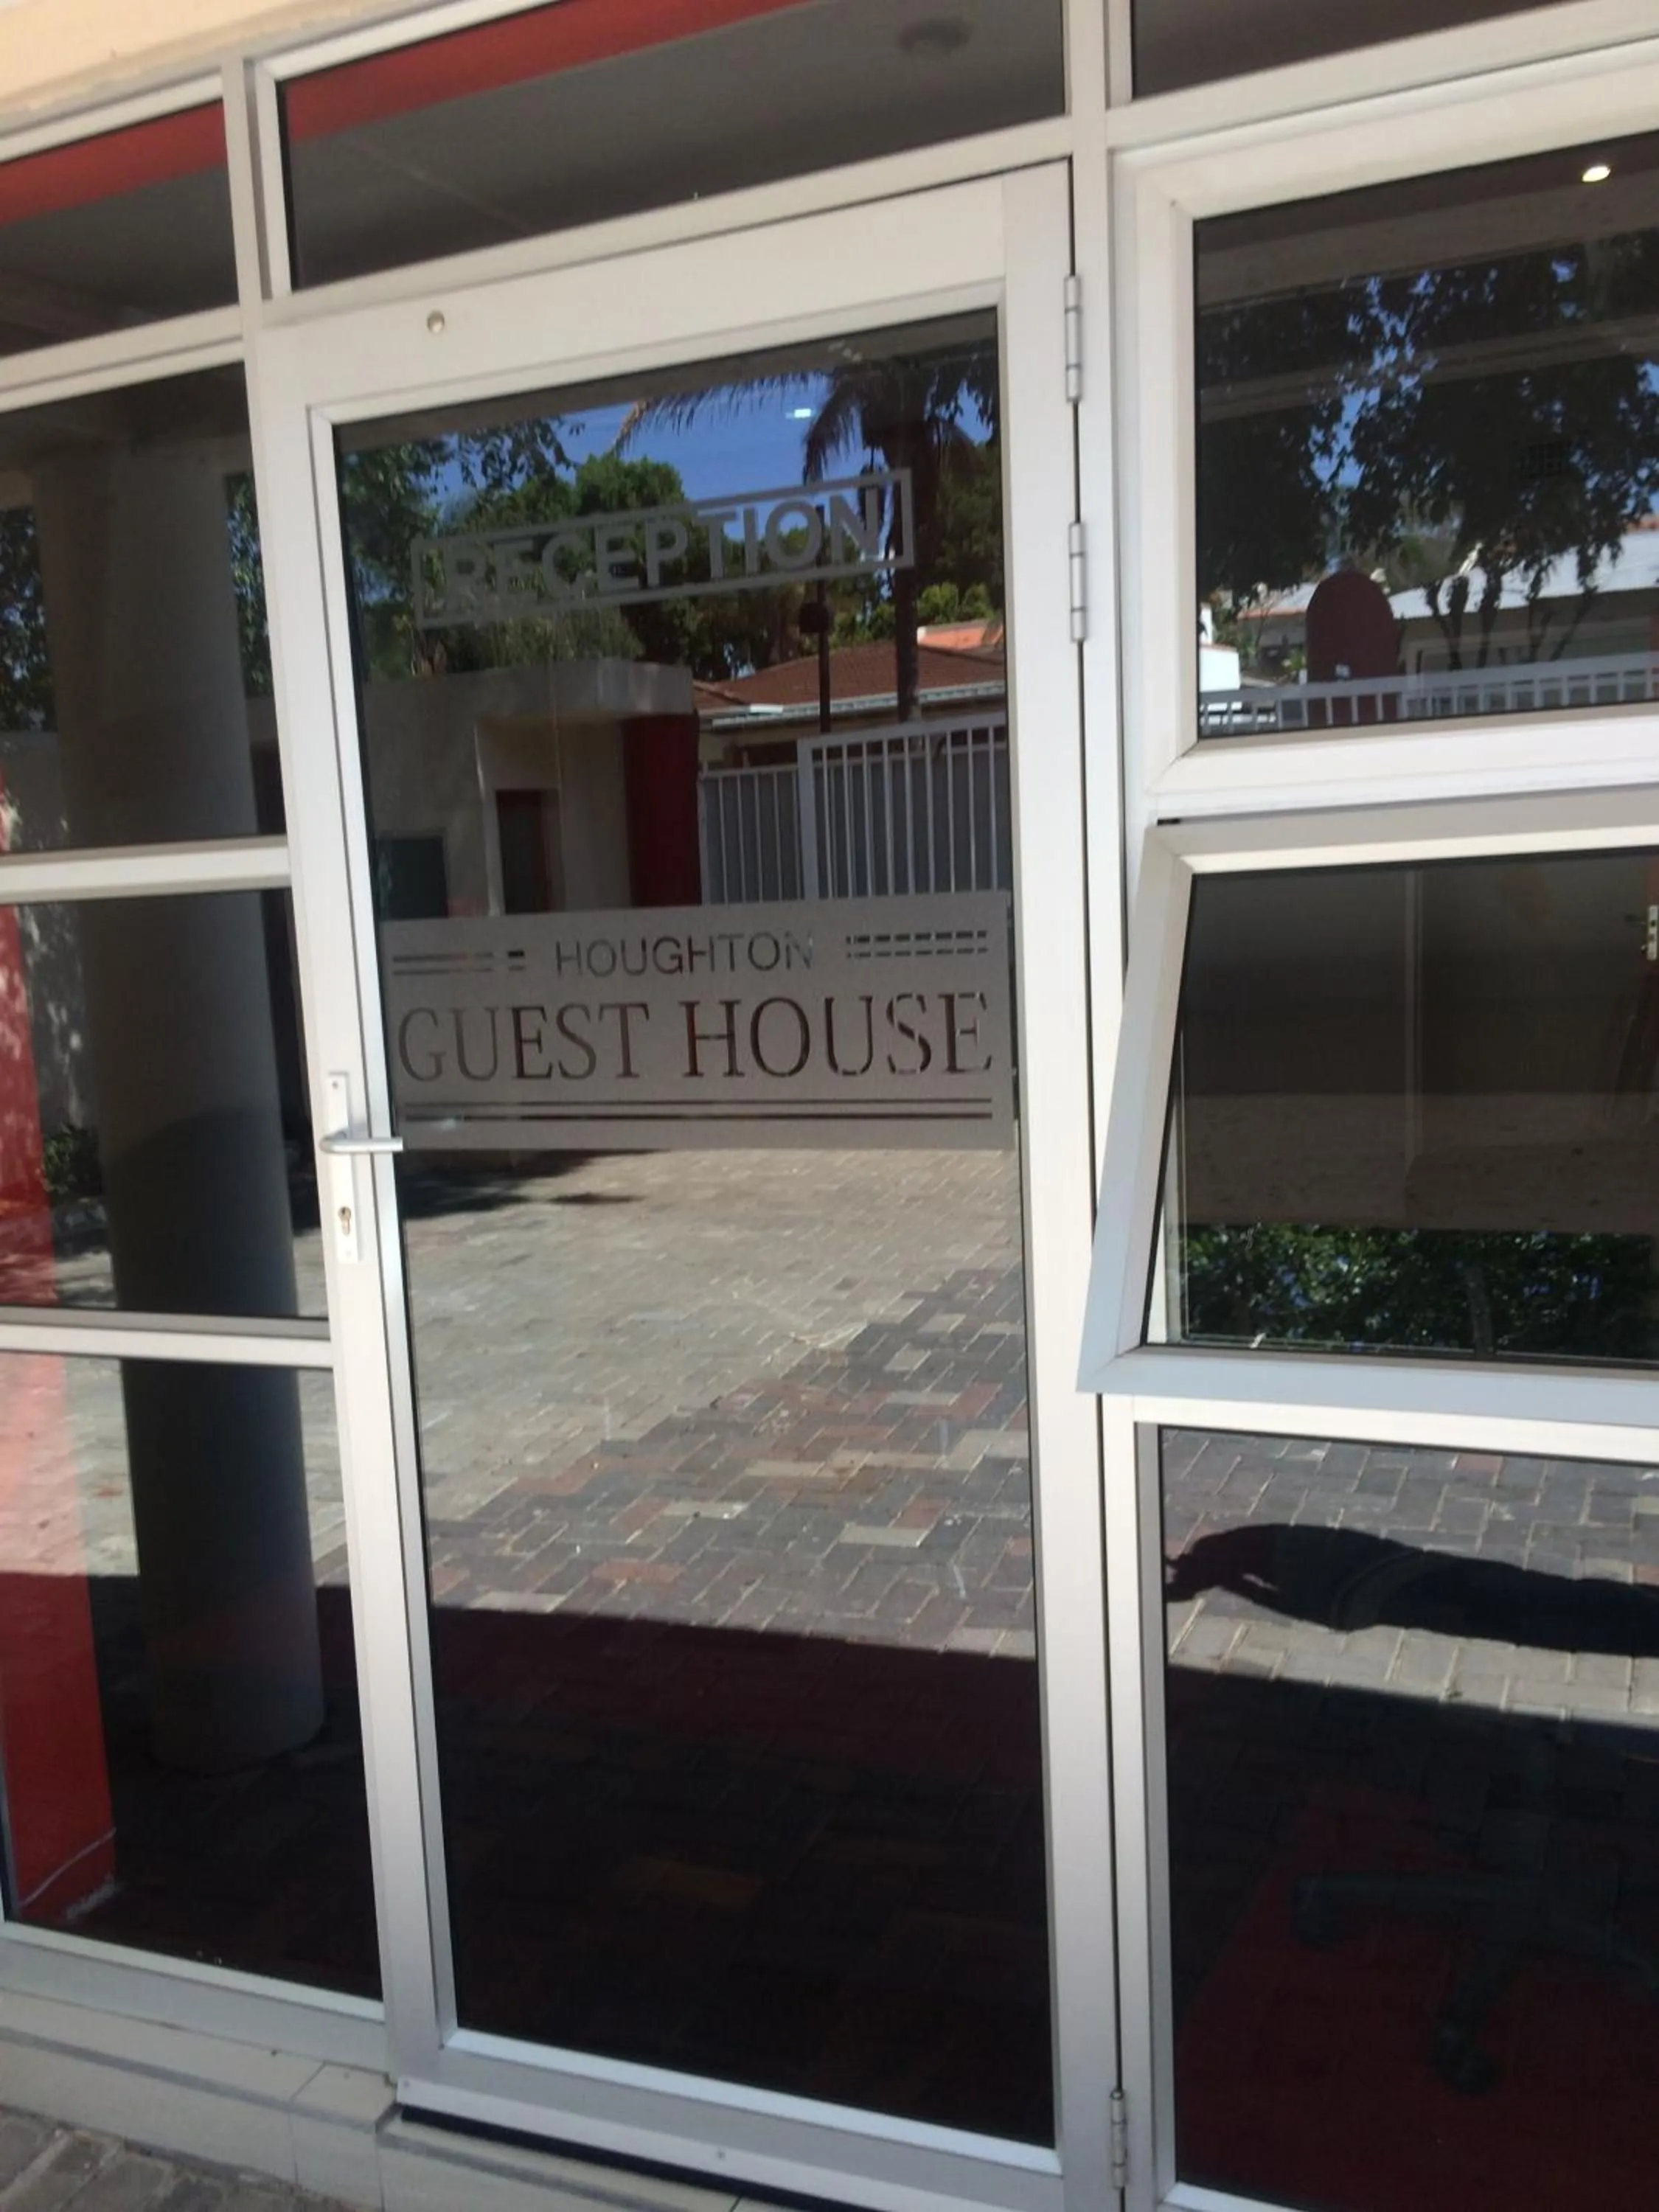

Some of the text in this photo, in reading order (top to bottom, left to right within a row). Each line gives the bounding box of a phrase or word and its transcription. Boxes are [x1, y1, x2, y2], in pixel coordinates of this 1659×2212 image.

[442, 493, 883, 612] RECEPTION
[555, 930, 814, 976] HOUGHTON
[399, 991, 994, 1082] GUEST HOUSE
